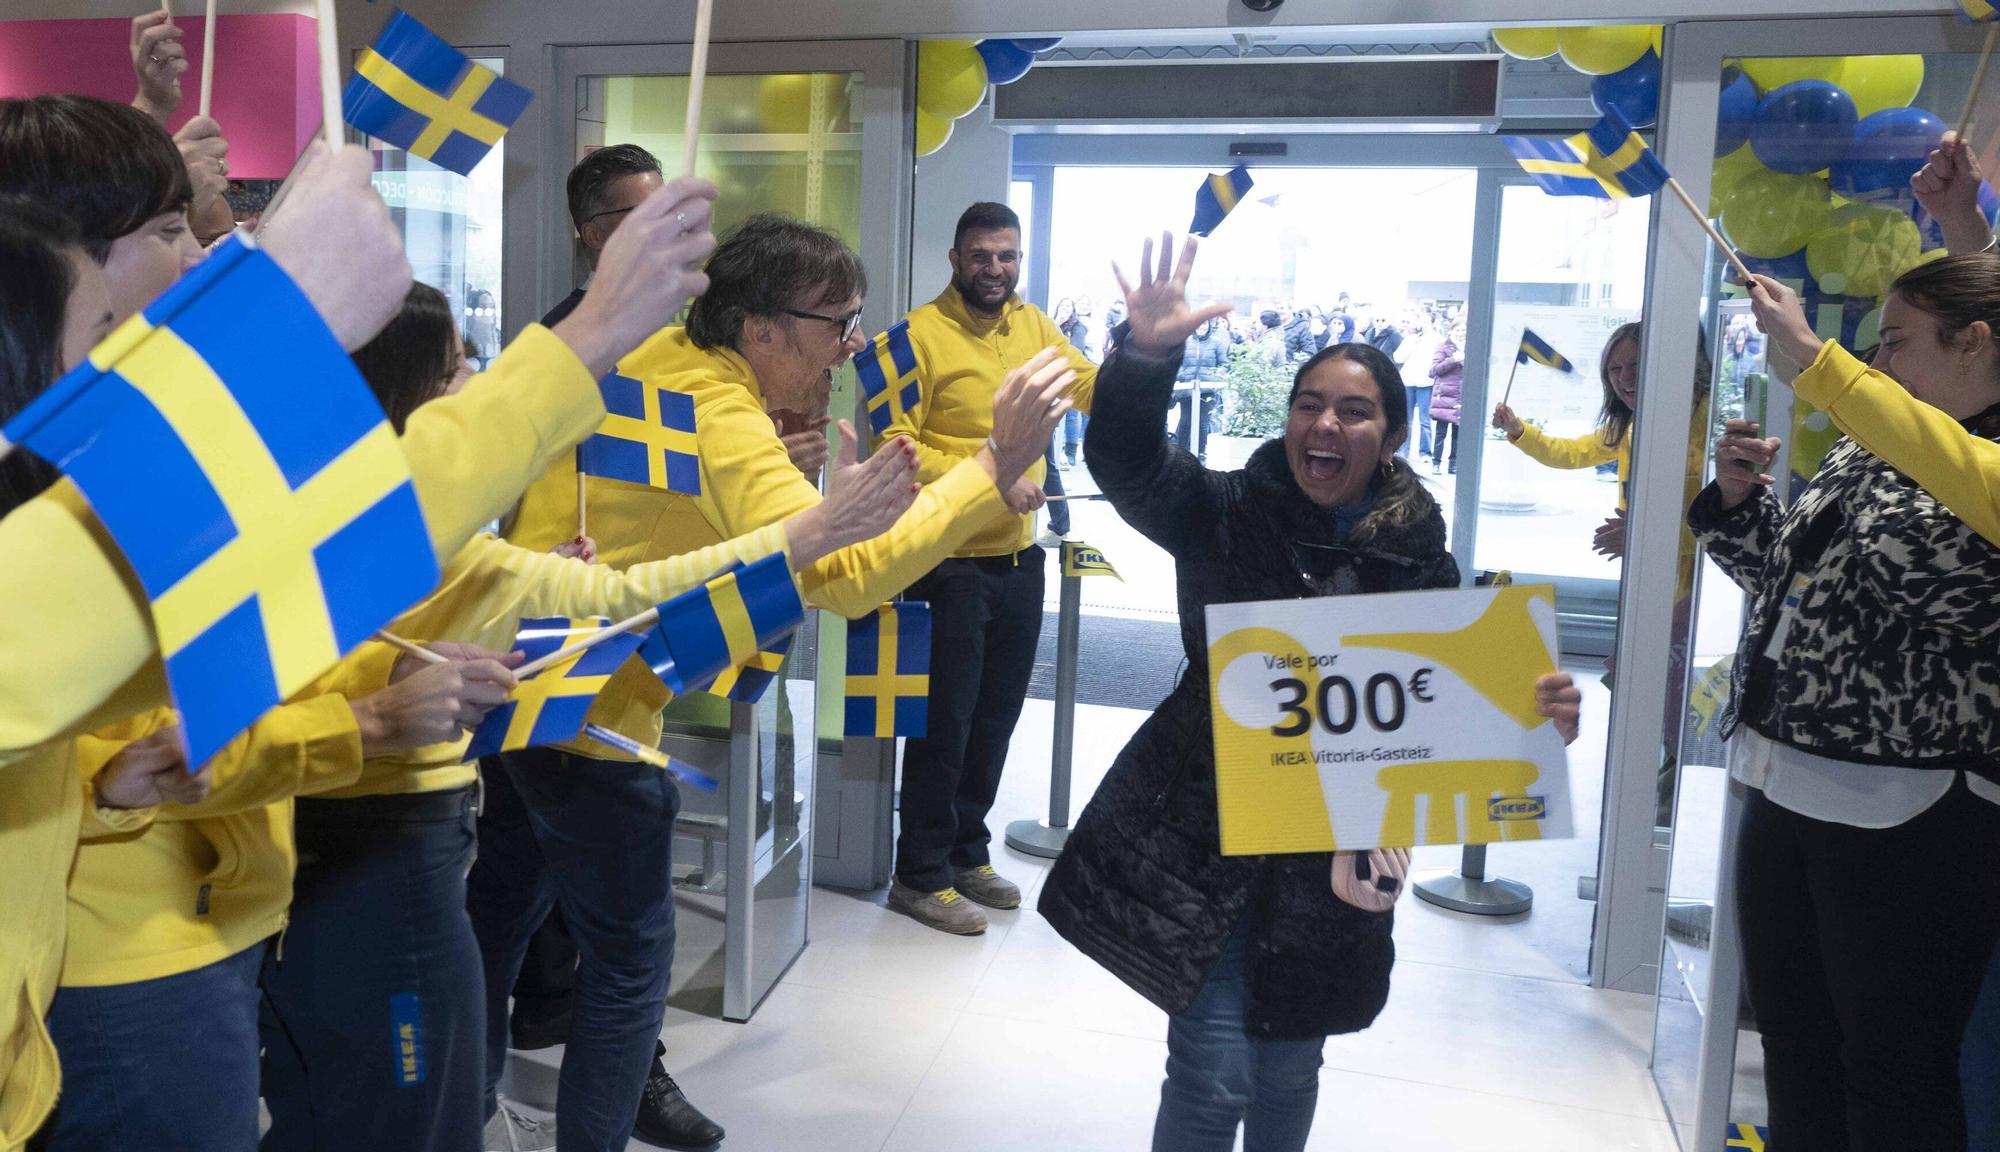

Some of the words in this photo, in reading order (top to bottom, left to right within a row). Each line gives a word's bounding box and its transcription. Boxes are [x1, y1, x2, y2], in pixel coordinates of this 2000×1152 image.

[1263, 653, 1304, 670] Vale
[1308, 652, 1339, 672] por
[1270, 667, 1435, 737] 300€
[1271, 752, 1306, 766] IKEA
[1310, 746, 1432, 765] Vitoria-Gasteiz
[1493, 803, 1540, 815] IKEA
[399, 1023, 417, 1082] IKEA
